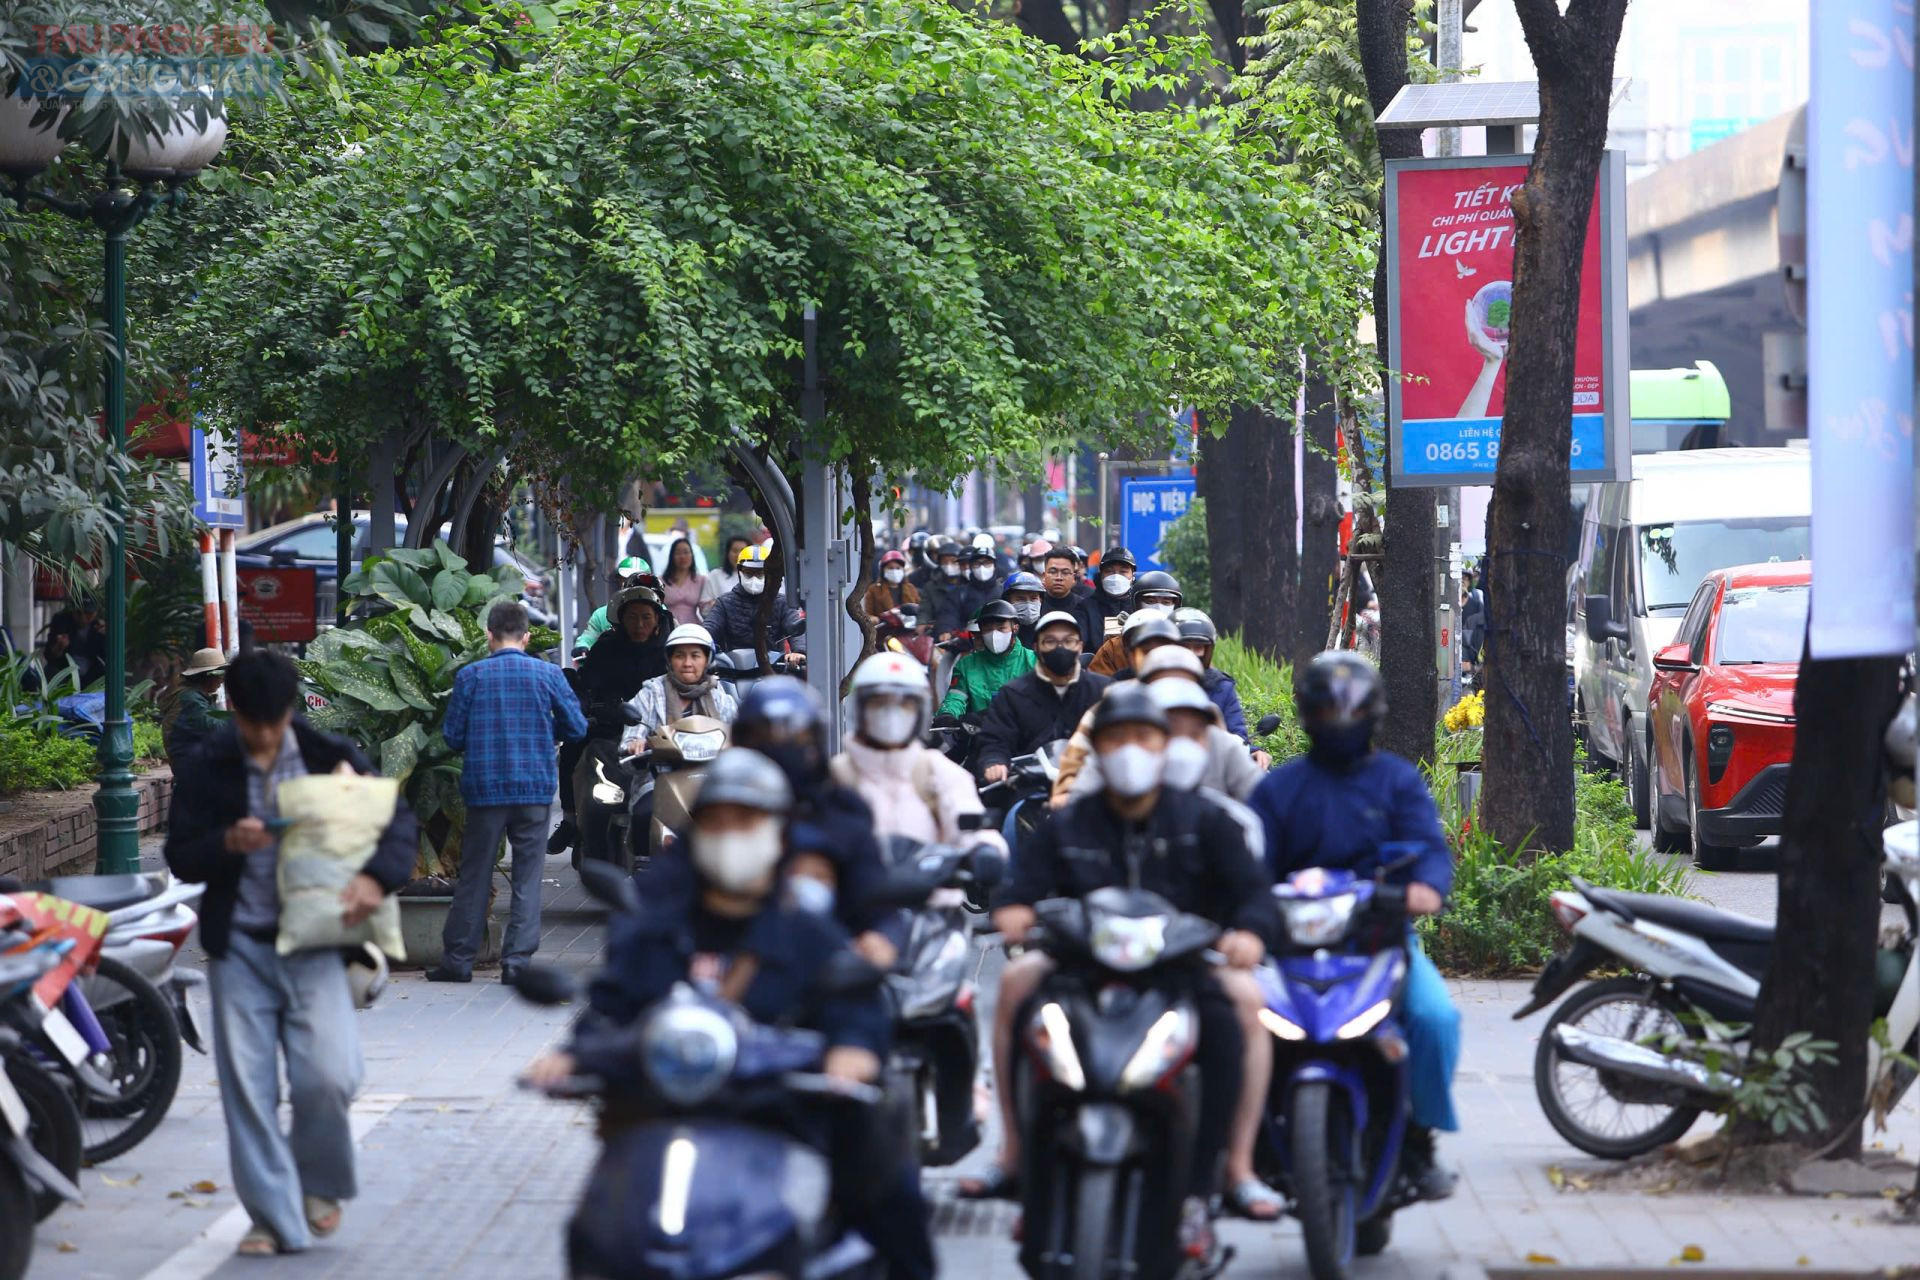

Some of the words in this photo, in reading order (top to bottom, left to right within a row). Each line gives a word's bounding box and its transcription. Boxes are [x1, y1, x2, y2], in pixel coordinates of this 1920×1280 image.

[1454, 182, 1500, 209] TIẾT
[1432, 216, 1454, 227] CHI
[1456, 210, 1480, 225] PHÍ
[1418, 226, 1510, 259] LIGHT
[1482, 426, 1495, 439] HỆ
[1426, 441, 1480, 461] 0865
[1132, 491, 1156, 517] HỌC
